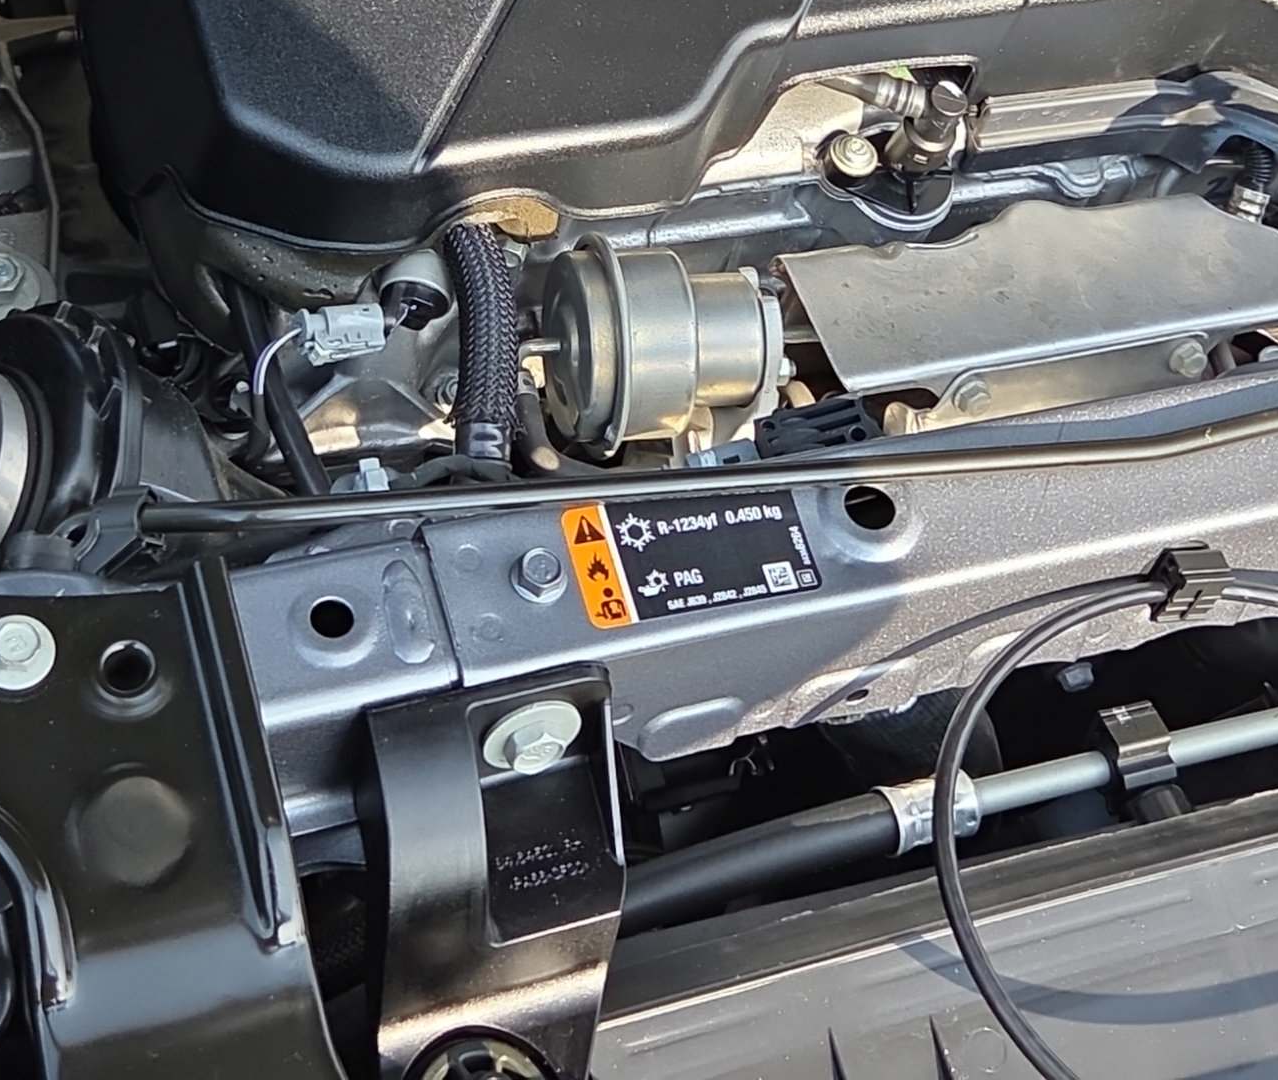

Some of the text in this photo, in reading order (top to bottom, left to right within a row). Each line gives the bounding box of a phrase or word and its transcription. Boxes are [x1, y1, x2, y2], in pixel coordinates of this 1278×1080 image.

[656, 504, 783, 536] R-1234yf 0.450 kg
[673, 568, 704, 588] PAG
